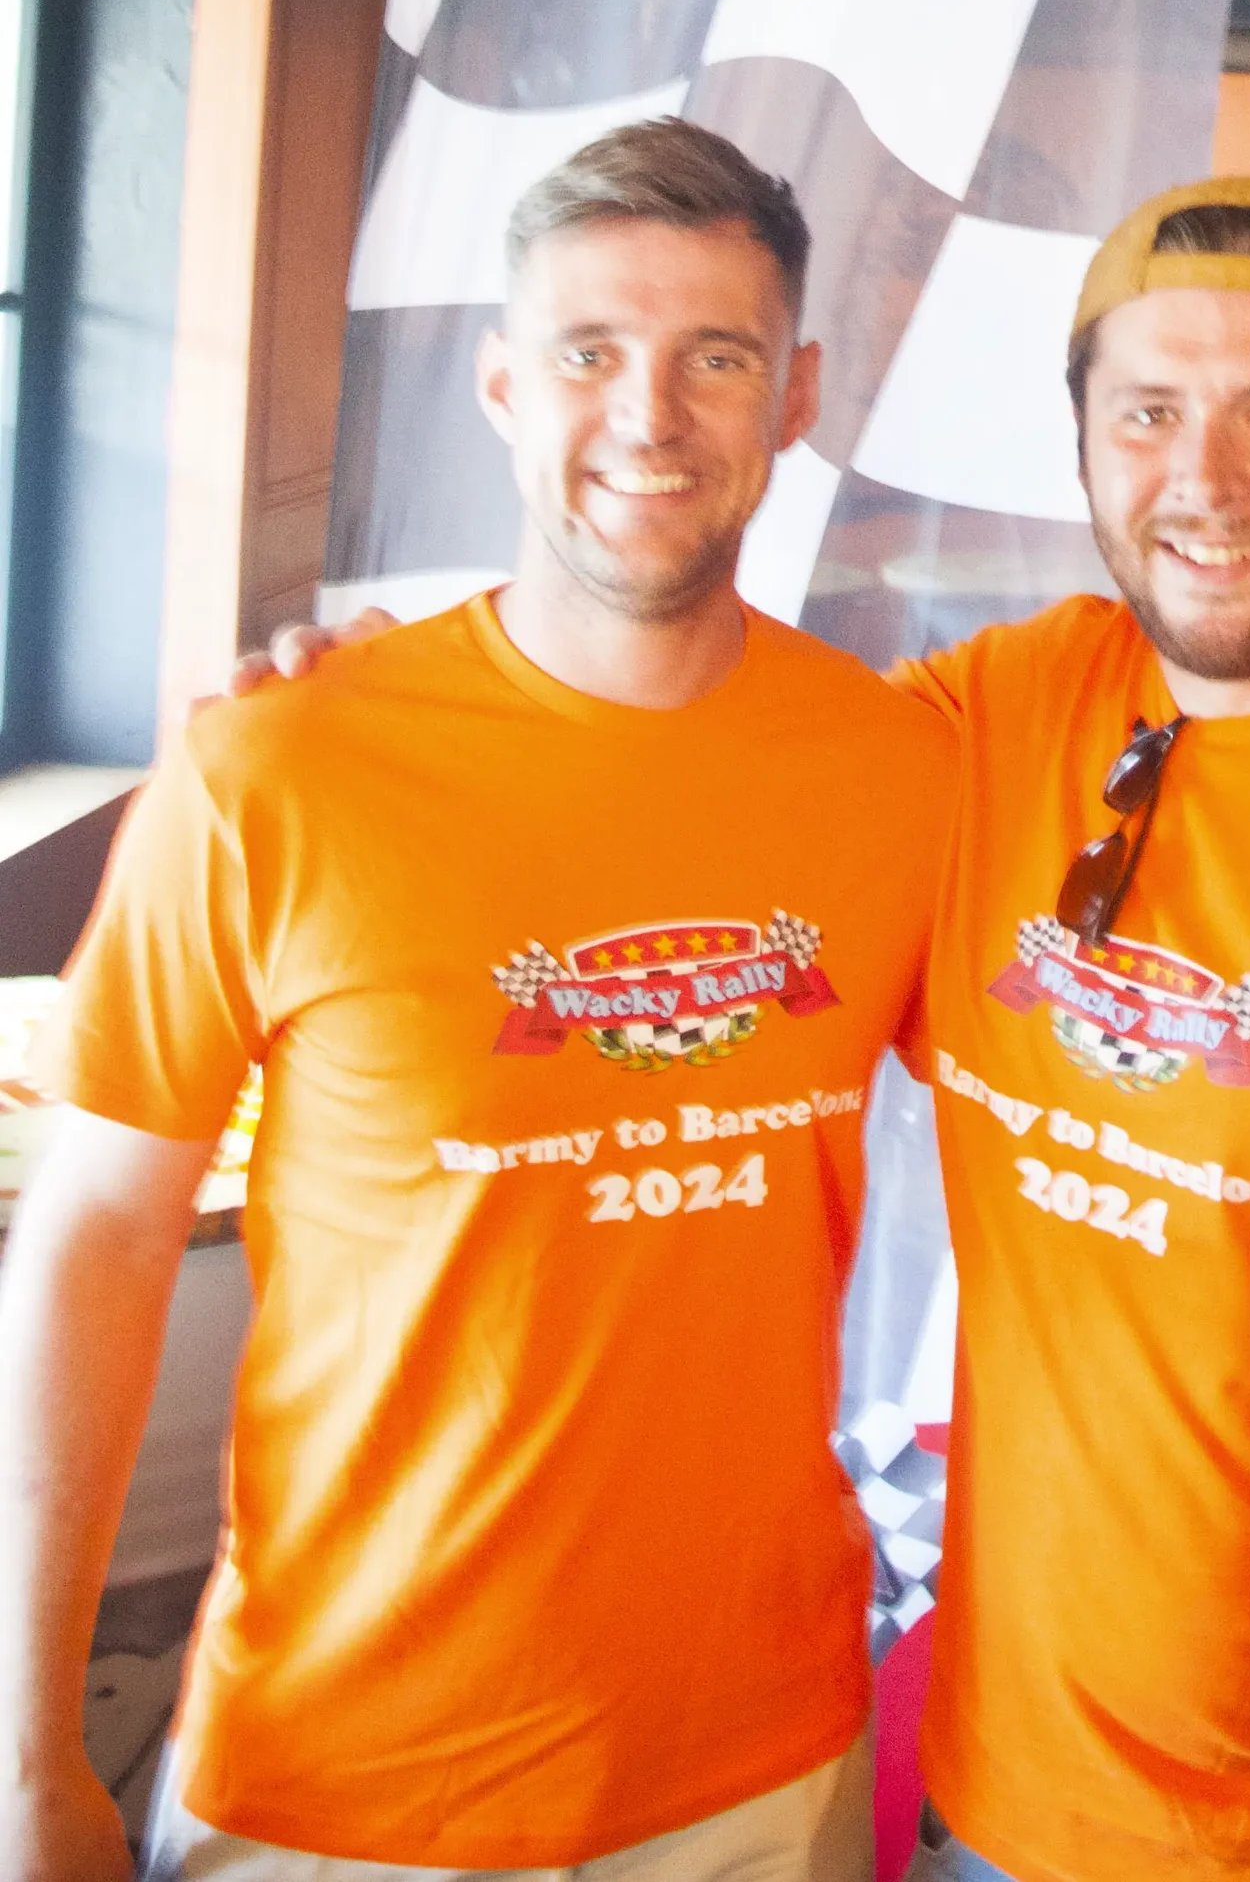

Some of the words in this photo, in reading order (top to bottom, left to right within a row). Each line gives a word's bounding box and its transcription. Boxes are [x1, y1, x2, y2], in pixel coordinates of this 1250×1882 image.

[547, 984, 682, 1019] Wacky
[692, 959, 787, 1006] Rally
[1036, 957, 1145, 1033] Wacky
[1149, 1006, 1229, 1049] Rally
[432, 1128, 602, 1174] Barmy
[614, 1118, 667, 1151] to
[1047, 1108, 1096, 1150] to
[589, 1154, 768, 1223] 2024
[1014, 1156, 1170, 1257] 2024
